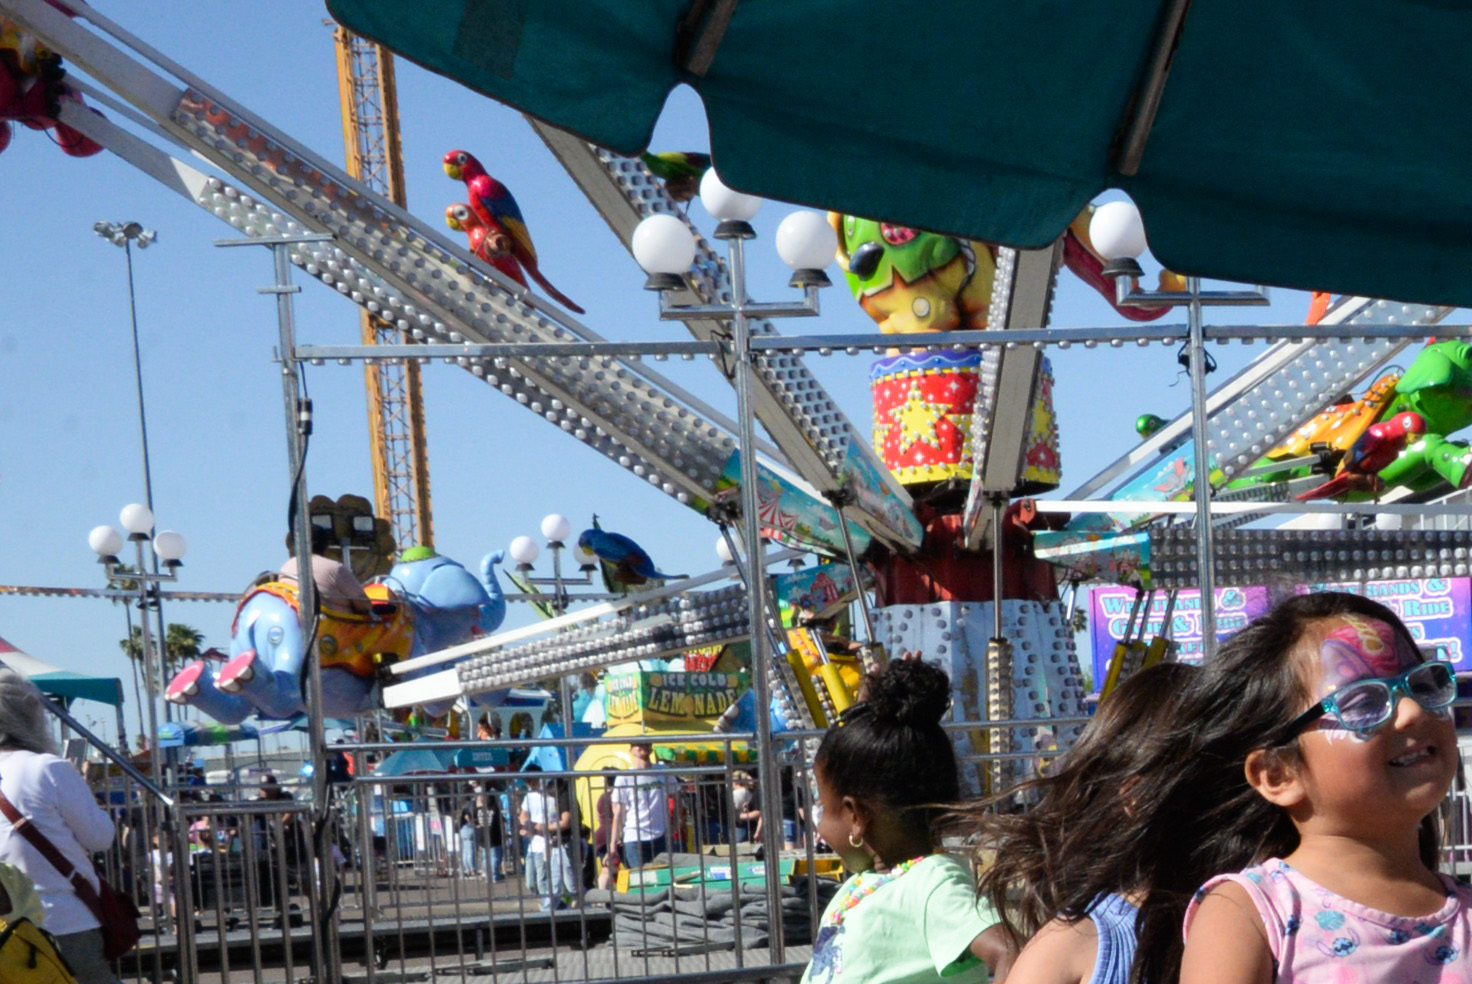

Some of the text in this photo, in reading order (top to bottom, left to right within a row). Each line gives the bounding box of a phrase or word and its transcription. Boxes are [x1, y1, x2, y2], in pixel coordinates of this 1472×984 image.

[1403, 599, 1450, 617] RIDE
[662, 674, 726, 687] ICE COLD
